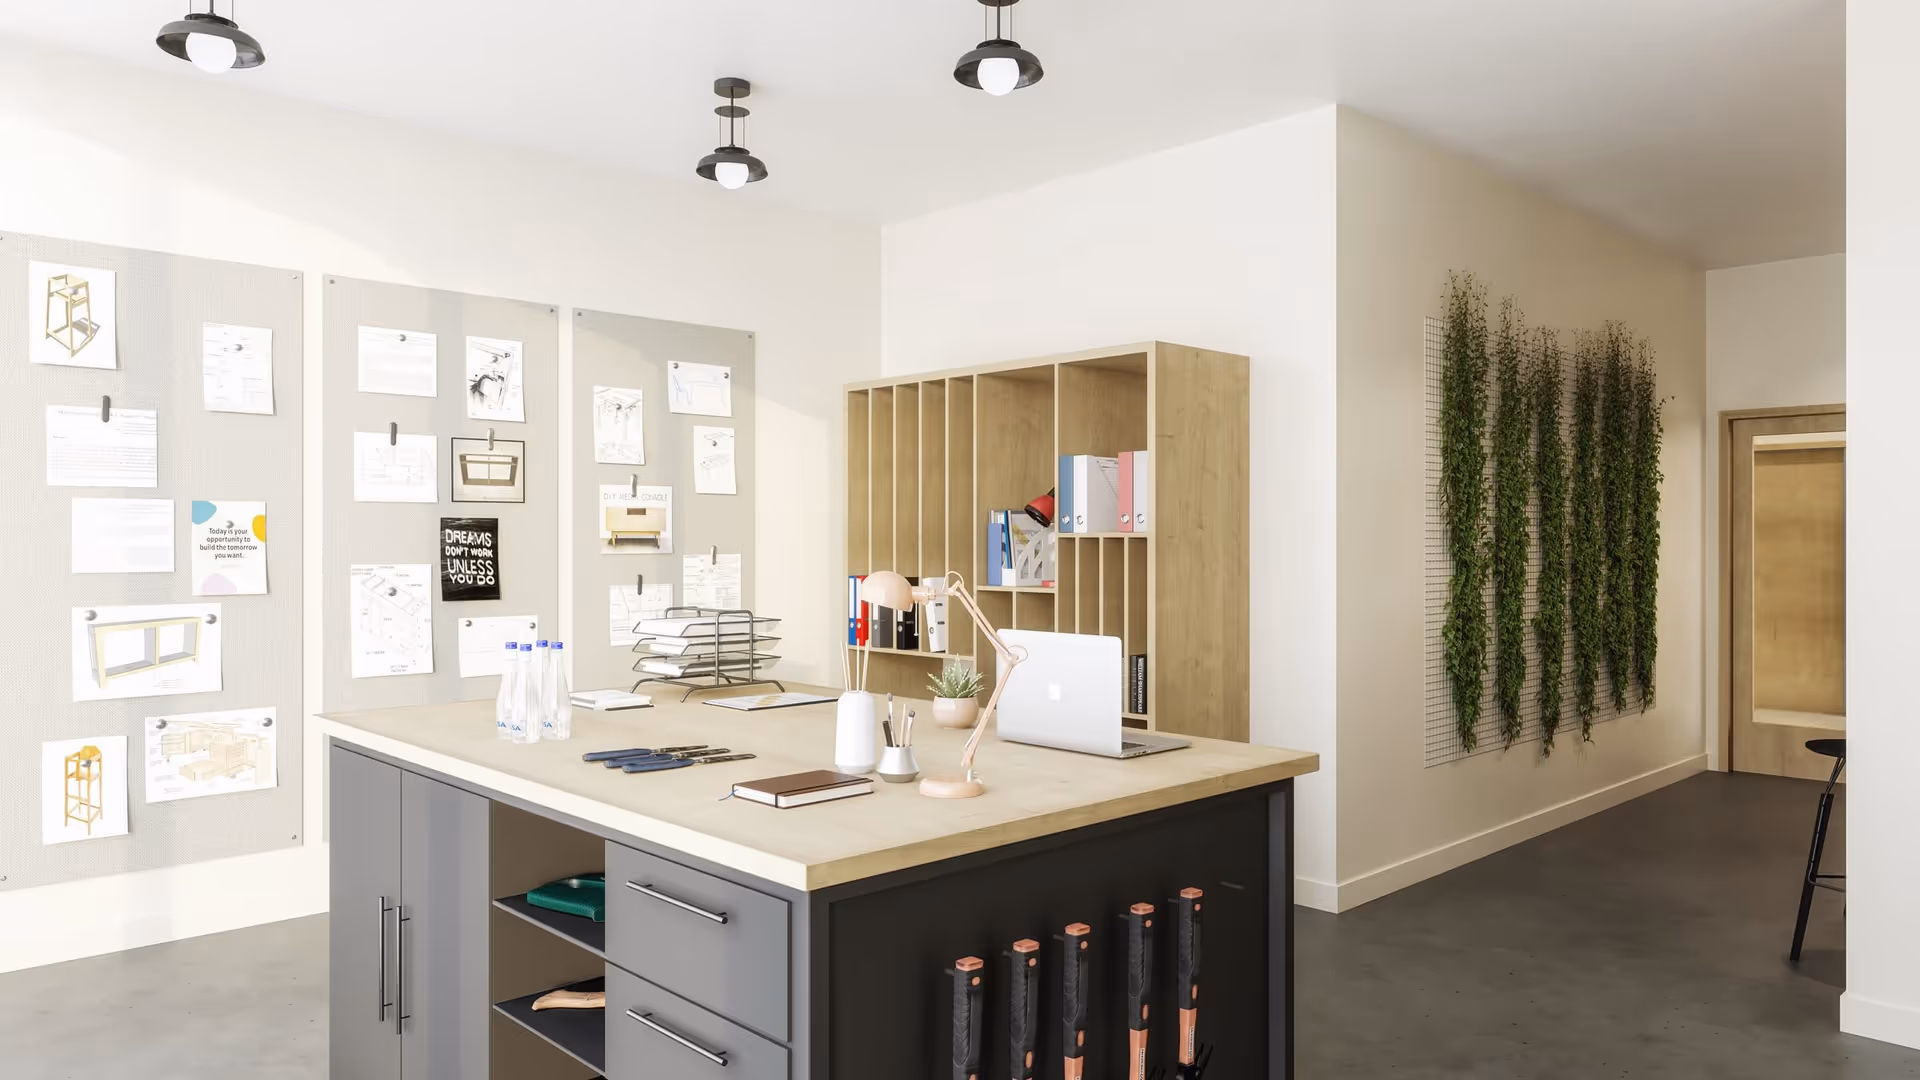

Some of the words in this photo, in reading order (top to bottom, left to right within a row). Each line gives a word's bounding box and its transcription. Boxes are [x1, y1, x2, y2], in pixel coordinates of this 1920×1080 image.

[445, 529, 492, 547] DREAMS
[445, 545, 469, 557] DON'T
[470, 547, 493, 558] WORK
[447, 558, 494, 575] UNLESS
[449, 574, 473, 584] YOU
[476, 575, 495, 585] DO
